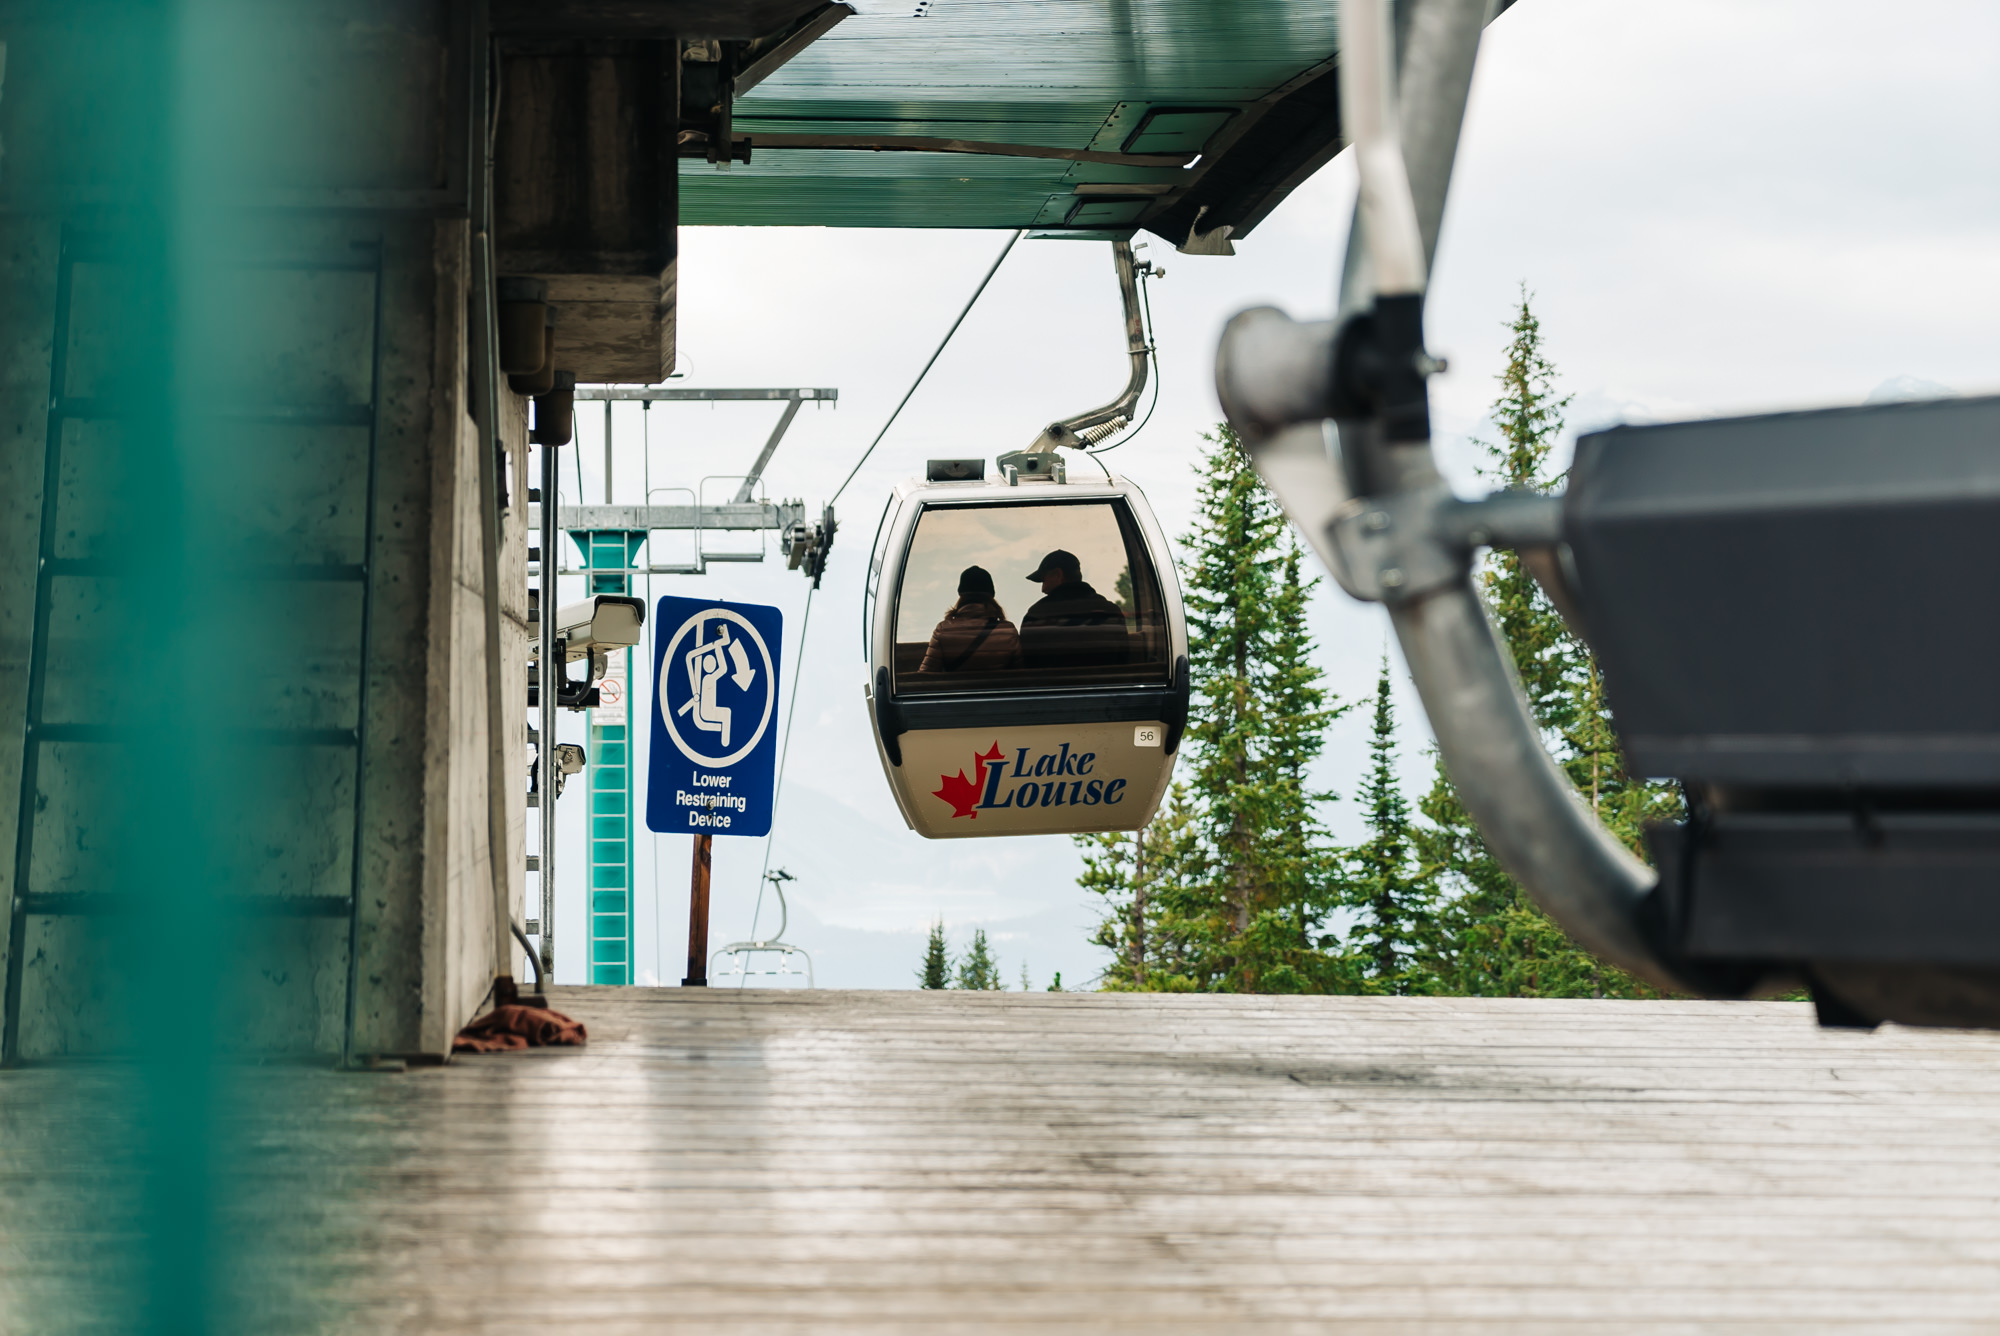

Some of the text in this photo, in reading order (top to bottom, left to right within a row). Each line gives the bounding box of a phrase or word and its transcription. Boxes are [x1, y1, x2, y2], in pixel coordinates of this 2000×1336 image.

[1140, 731, 1154, 741] 56
[1010, 742, 1096, 778] Lake
[692, 770, 732, 788] Lower
[975, 761, 1127, 809] Louise
[675, 790, 746, 812] Restraining
[688, 810, 731, 828] Device
